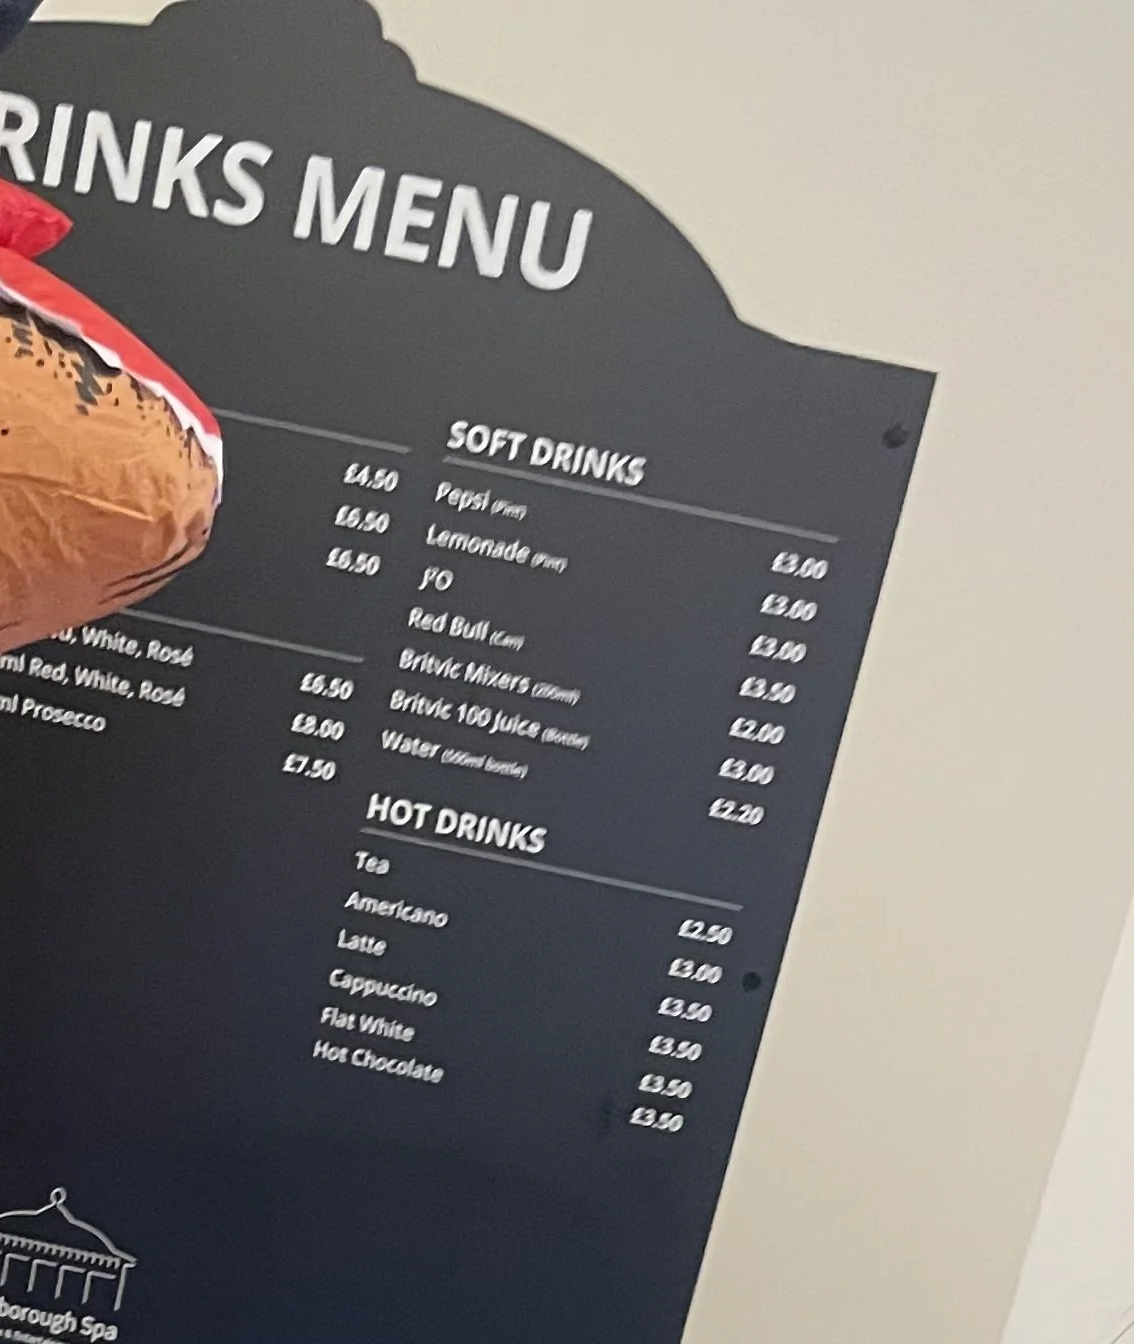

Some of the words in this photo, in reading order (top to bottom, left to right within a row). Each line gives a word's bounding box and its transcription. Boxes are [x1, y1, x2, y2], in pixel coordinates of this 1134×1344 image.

[293, 154, 593, 290] MENU
[447, 420, 527, 462] SOFT
[529, 437, 647, 487] DRINKS
[343, 463, 400, 492] £4.50
[435, 481, 491, 512] Pepsi
[334, 505, 391, 534] £6.50
[426, 523, 530, 564] Lemonade
[326, 546, 381, 576] £6.50
[770, 551, 829, 580] £3.00
[759, 593, 819, 622] £3.00
[408, 606, 449, 633] Red
[449, 615, 491, 640] Bull
[81, 626, 142, 660] White,
[146, 639, 195, 668] Rosé
[748, 634, 808, 663] £3.00
[28, 656, 70, 686] Red,
[74, 665, 136, 699] White,
[138, 678, 187, 708] Rosé
[399, 648, 464, 680] Britvic
[463, 661, 531, 694] Mixers
[299, 671, 355, 702] £6.50
[738, 675, 797, 704] £3.50
[20, 698, 108, 733] Prosecco
[290, 711, 347, 742] £8.00
[390, 689, 454, 720] Britvic
[457, 702, 493, 728] 100
[488, 709, 541, 739] Juice
[381, 729, 442, 759] Water
[728, 716, 787, 745] £2.00
[282, 752, 338, 783] £7.50
[718, 756, 776, 786] £3.00
[366, 793, 433, 831] HOT
[434, 806, 548, 854] DRINKS
[708, 796, 766, 826] £2.20
[354, 850, 391, 877] Tea
[344, 890, 450, 929] Americano
[337, 929, 388, 958] Latte
[677, 918, 734, 946] £2.50
[667, 957, 724, 985] £3.00
[328, 968, 439, 1008] Cappuccino
[321, 1006, 357, 1031] Flat
[358, 1014, 416, 1043] White
[657, 996, 713, 1023] £3.50
[312, 1040, 350, 1065] Hot
[351, 1046, 446, 1086] Chocolate
[648, 1034, 703, 1062] £3.50
[638, 1072, 694, 1100] £3.50
[628, 1106, 685, 1133] £3.50
[78, 1315, 119, 1344] Spa
